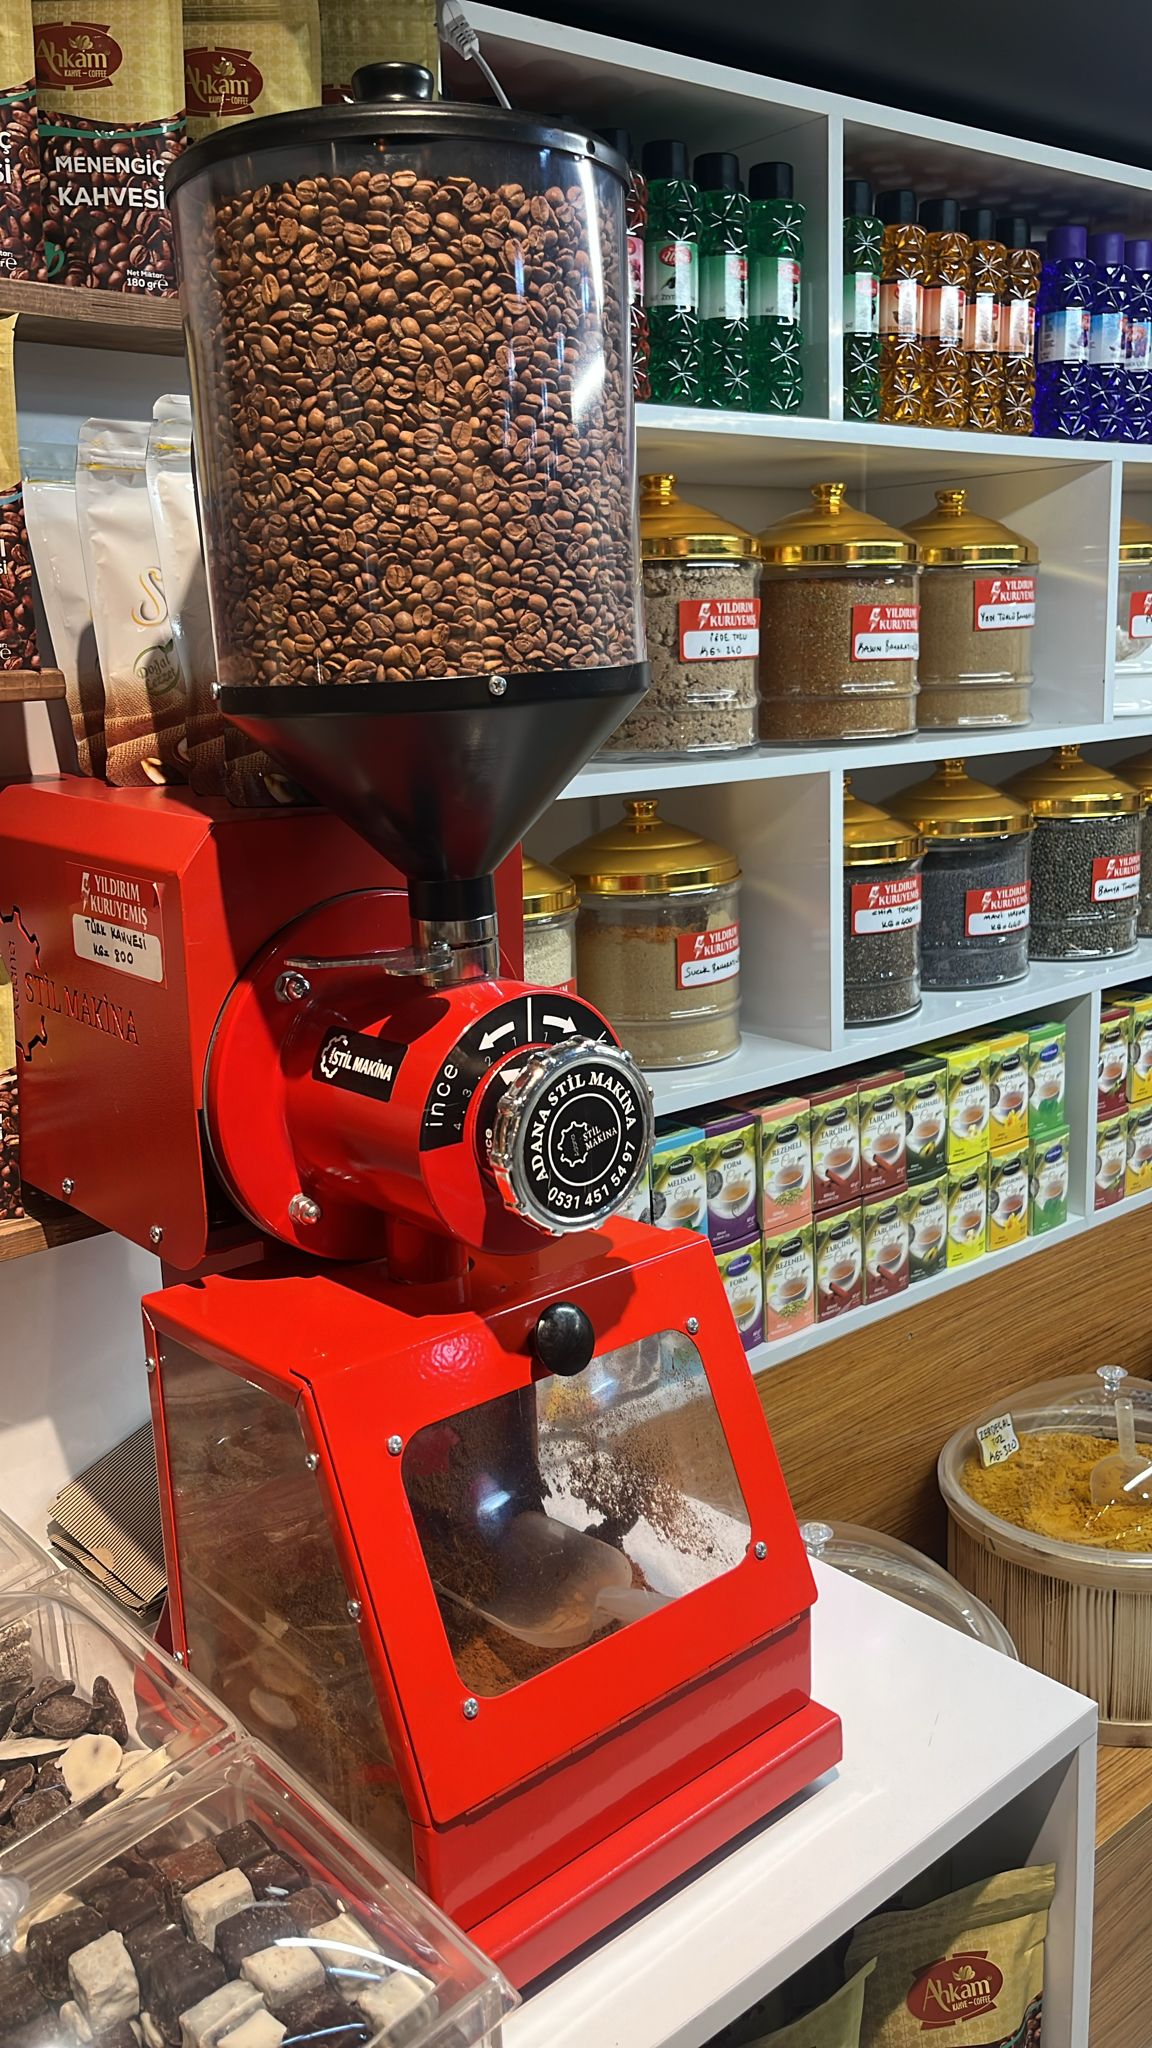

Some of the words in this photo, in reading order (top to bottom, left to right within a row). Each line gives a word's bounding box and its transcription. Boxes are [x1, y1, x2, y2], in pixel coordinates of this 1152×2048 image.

[36, 38, 109, 76] Ahkam
[64, 69, 82, 78] KAHVE
[88, 68, 107, 78] COFFEE
[186, 66, 250, 103] Ahkam
[231, 96, 249, 106] COFFEE
[55, 154, 166, 182] MENENGİÇ
[58, 185, 166, 210] KAHVESİ
[126, 269, 140, 278] Net
[126, 277, 145, 288] 180
[94, 874, 141, 903] YILDIRIM
[90, 893, 148, 931] KURUYEMİŞ
[85, 917, 106, 937] TÜRK
[111, 927, 147, 951] KAHVESİ
[114, 948, 135, 965] 800
[24, 972, 62, 1015] STİL
[64, 985, 141, 1047] MAKİNA
[352, 1058, 394, 1082] MAKİNA
[484, 1055, 494, 1067] 2
[425, 1063, 460, 1127] ince
[462, 1087, 473, 1099] 3
[530, 1107, 552, 1182] ADANA
[548, 1073, 587, 1107] STİL
[588, 1071, 637, 1131] MAKİNA
[582, 1125, 601, 1142] STİL
[585, 1126, 618, 1152] MAKİNA
[548, 1186, 580, 1209] 0531
[584, 1183, 611, 1207] 451
[610, 1164, 628, 1187] 54
[622, 1141, 636, 1163] 97
[722, 1159, 742, 1172] FORM
[729, 1275, 748, 1288] FORM
[923, 1978, 991, 2013] Ahkam
[952, 1999, 969, 2012] KAHVE
[973, 1994, 992, 2007] COFFEE
